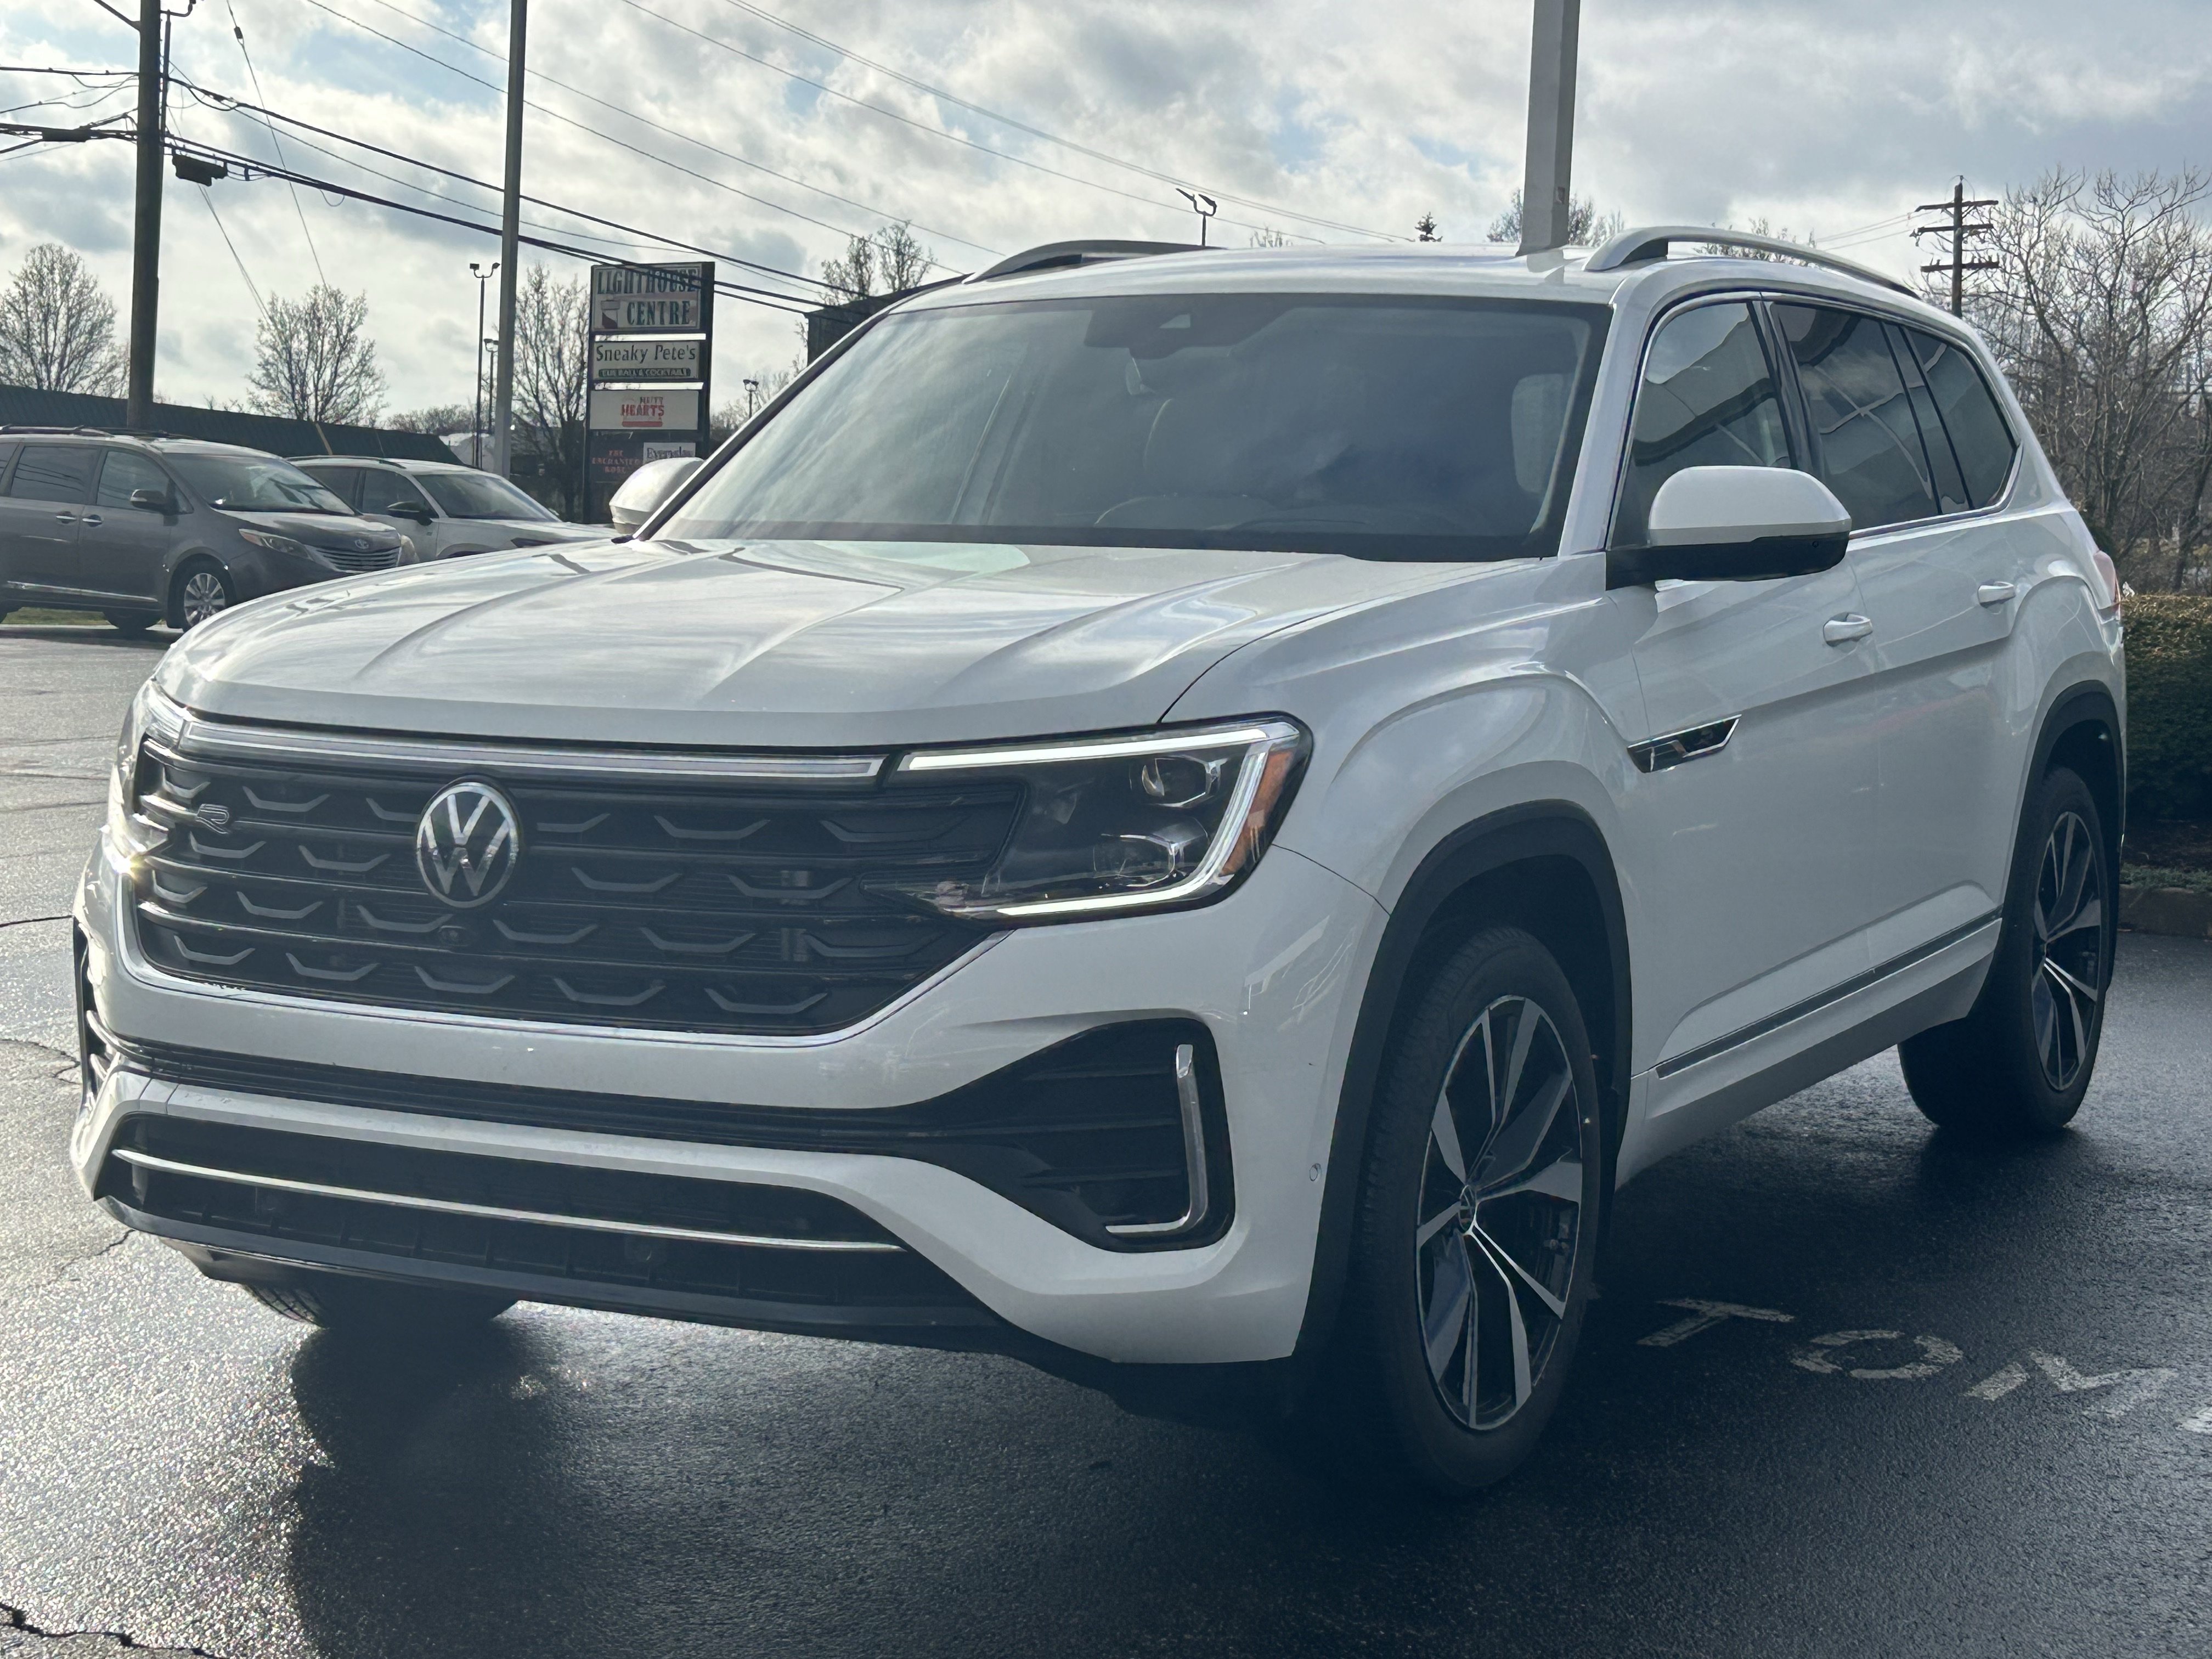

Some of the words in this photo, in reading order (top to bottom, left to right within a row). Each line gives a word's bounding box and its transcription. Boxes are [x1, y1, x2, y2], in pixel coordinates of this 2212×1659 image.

[597, 268, 697, 294] LIGHTHOUSE
[627, 301, 691, 325] CENTRE
[596, 345, 648, 364] Sneaky
[654, 345, 696, 361] Pete's
[621, 404, 665, 416] HEARTS
